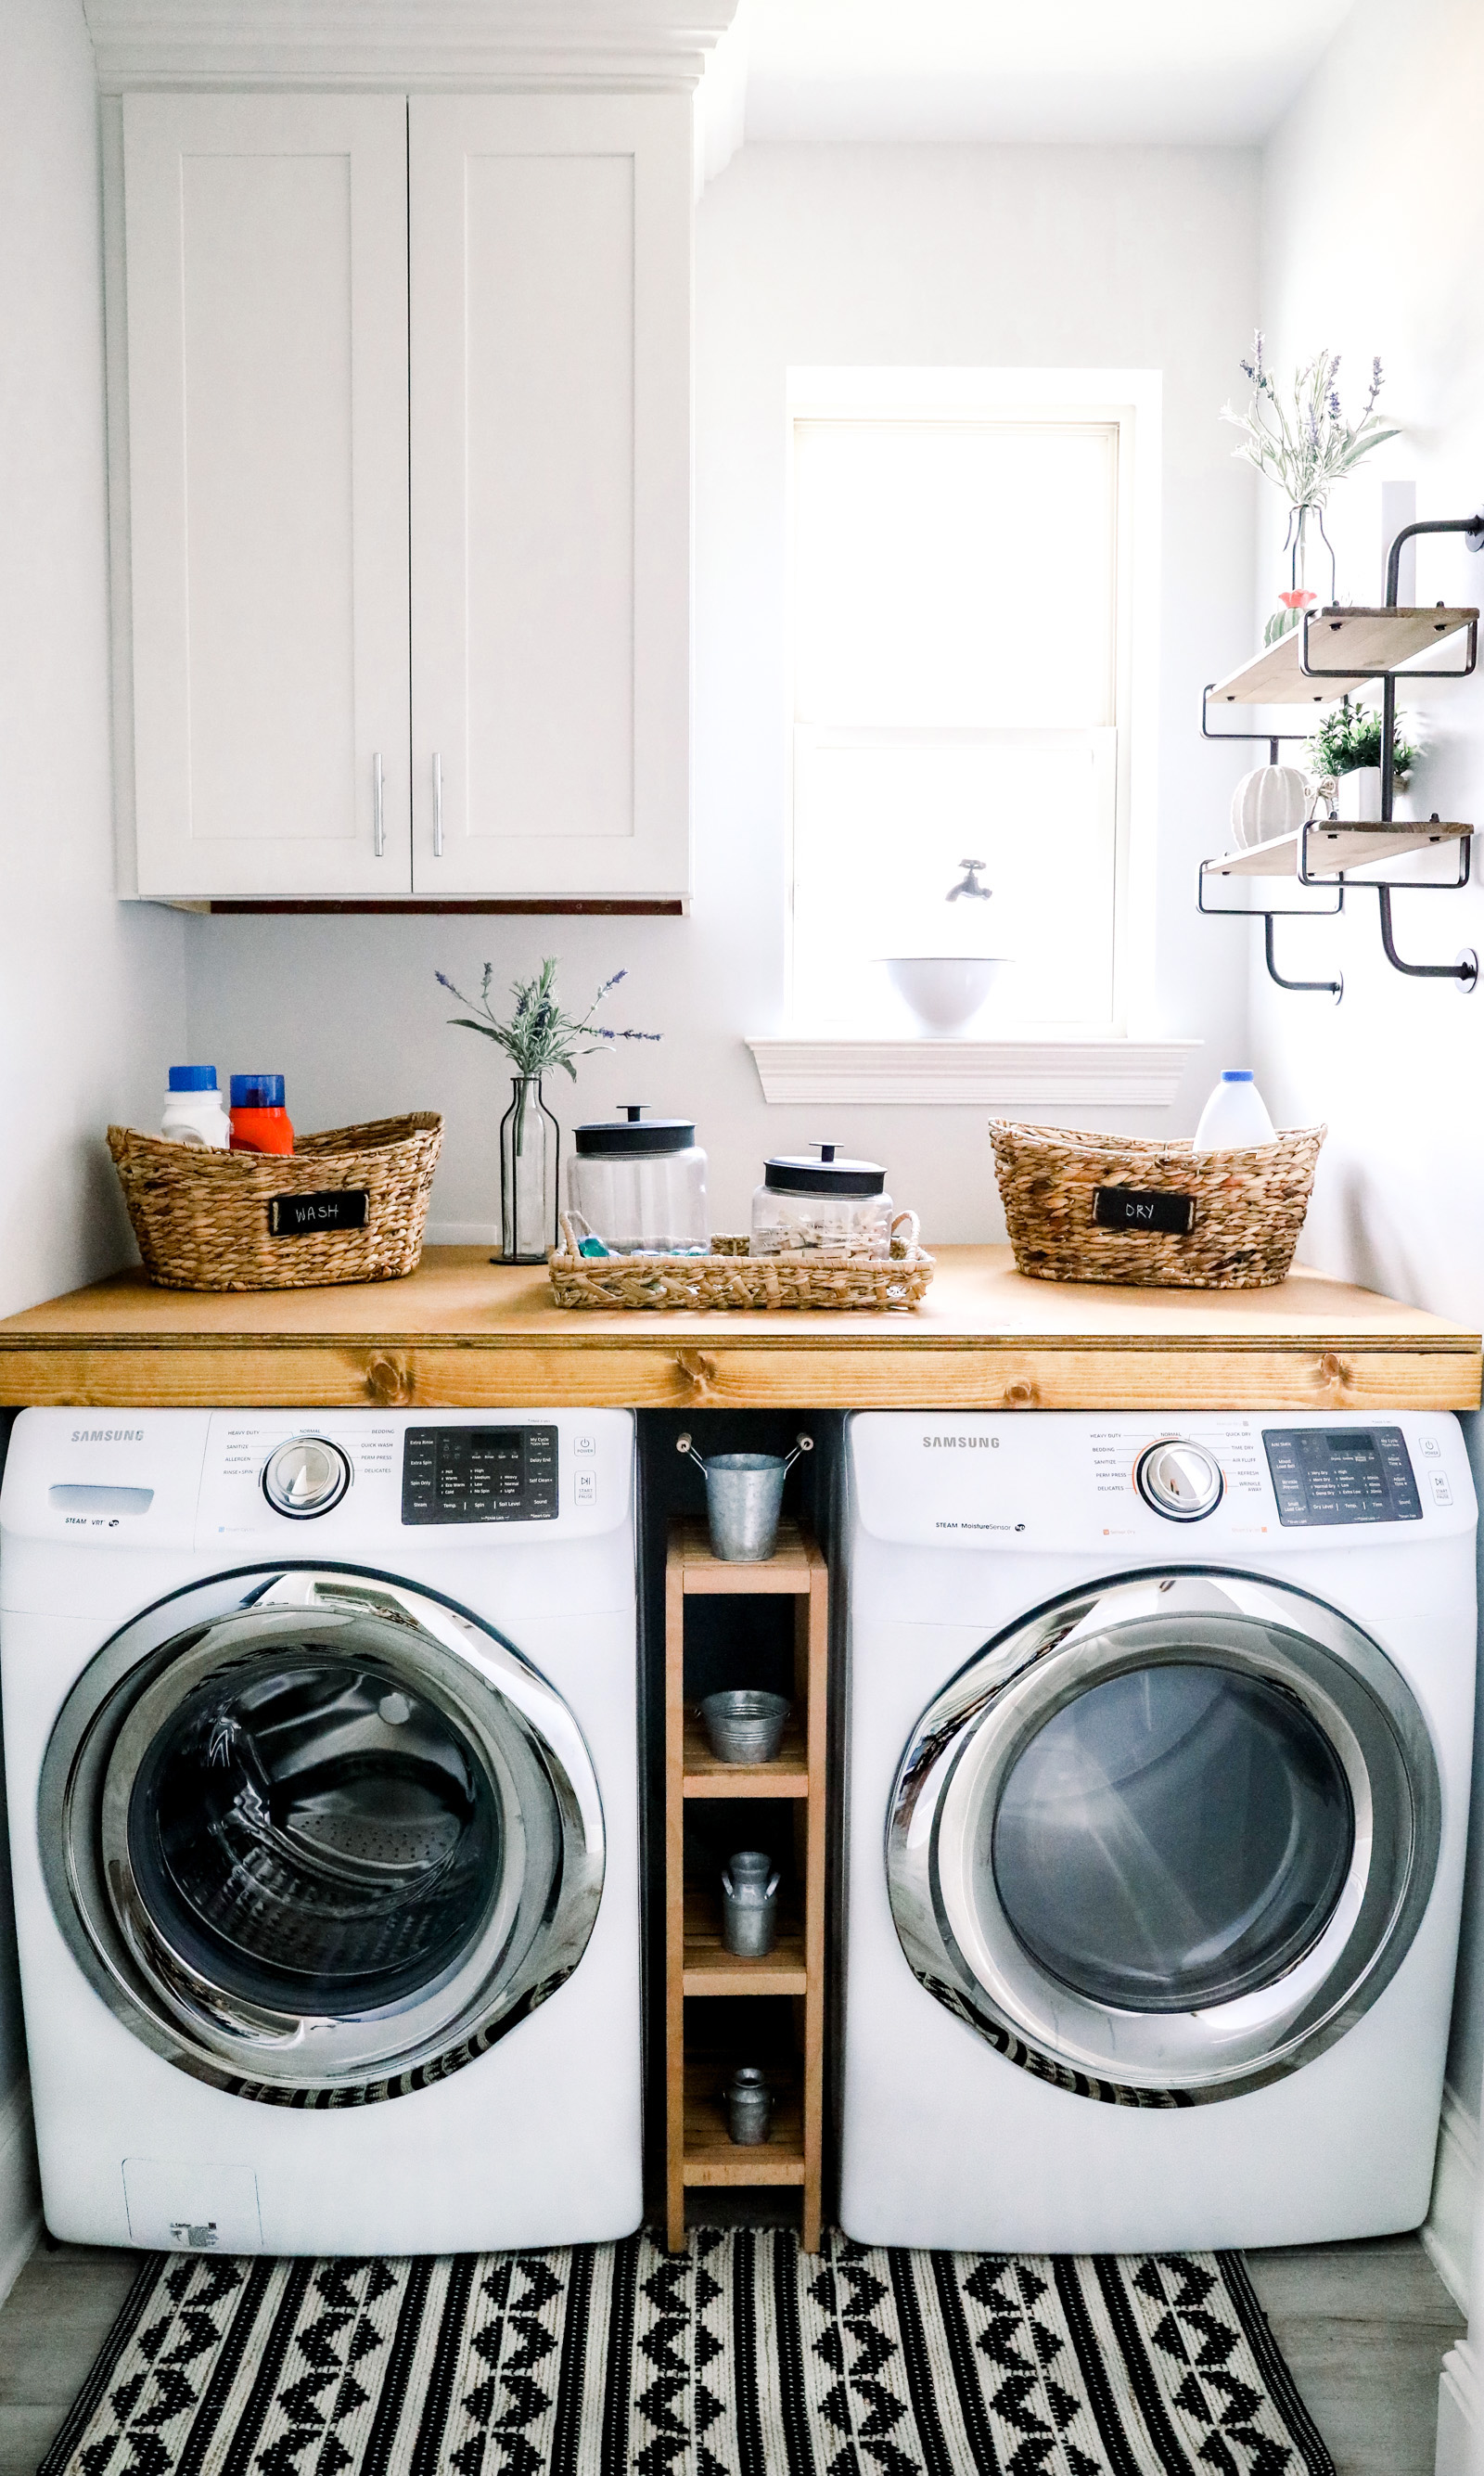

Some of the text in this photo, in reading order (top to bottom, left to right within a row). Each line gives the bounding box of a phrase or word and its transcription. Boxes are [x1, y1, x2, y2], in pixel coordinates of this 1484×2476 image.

[295, 1203, 339, 1223] WASH
[1125, 1203, 1154, 1219] DRY
[71, 1430, 144, 1442] SAMSUNG
[923, 1436, 1000, 1448] SAMSUNG
